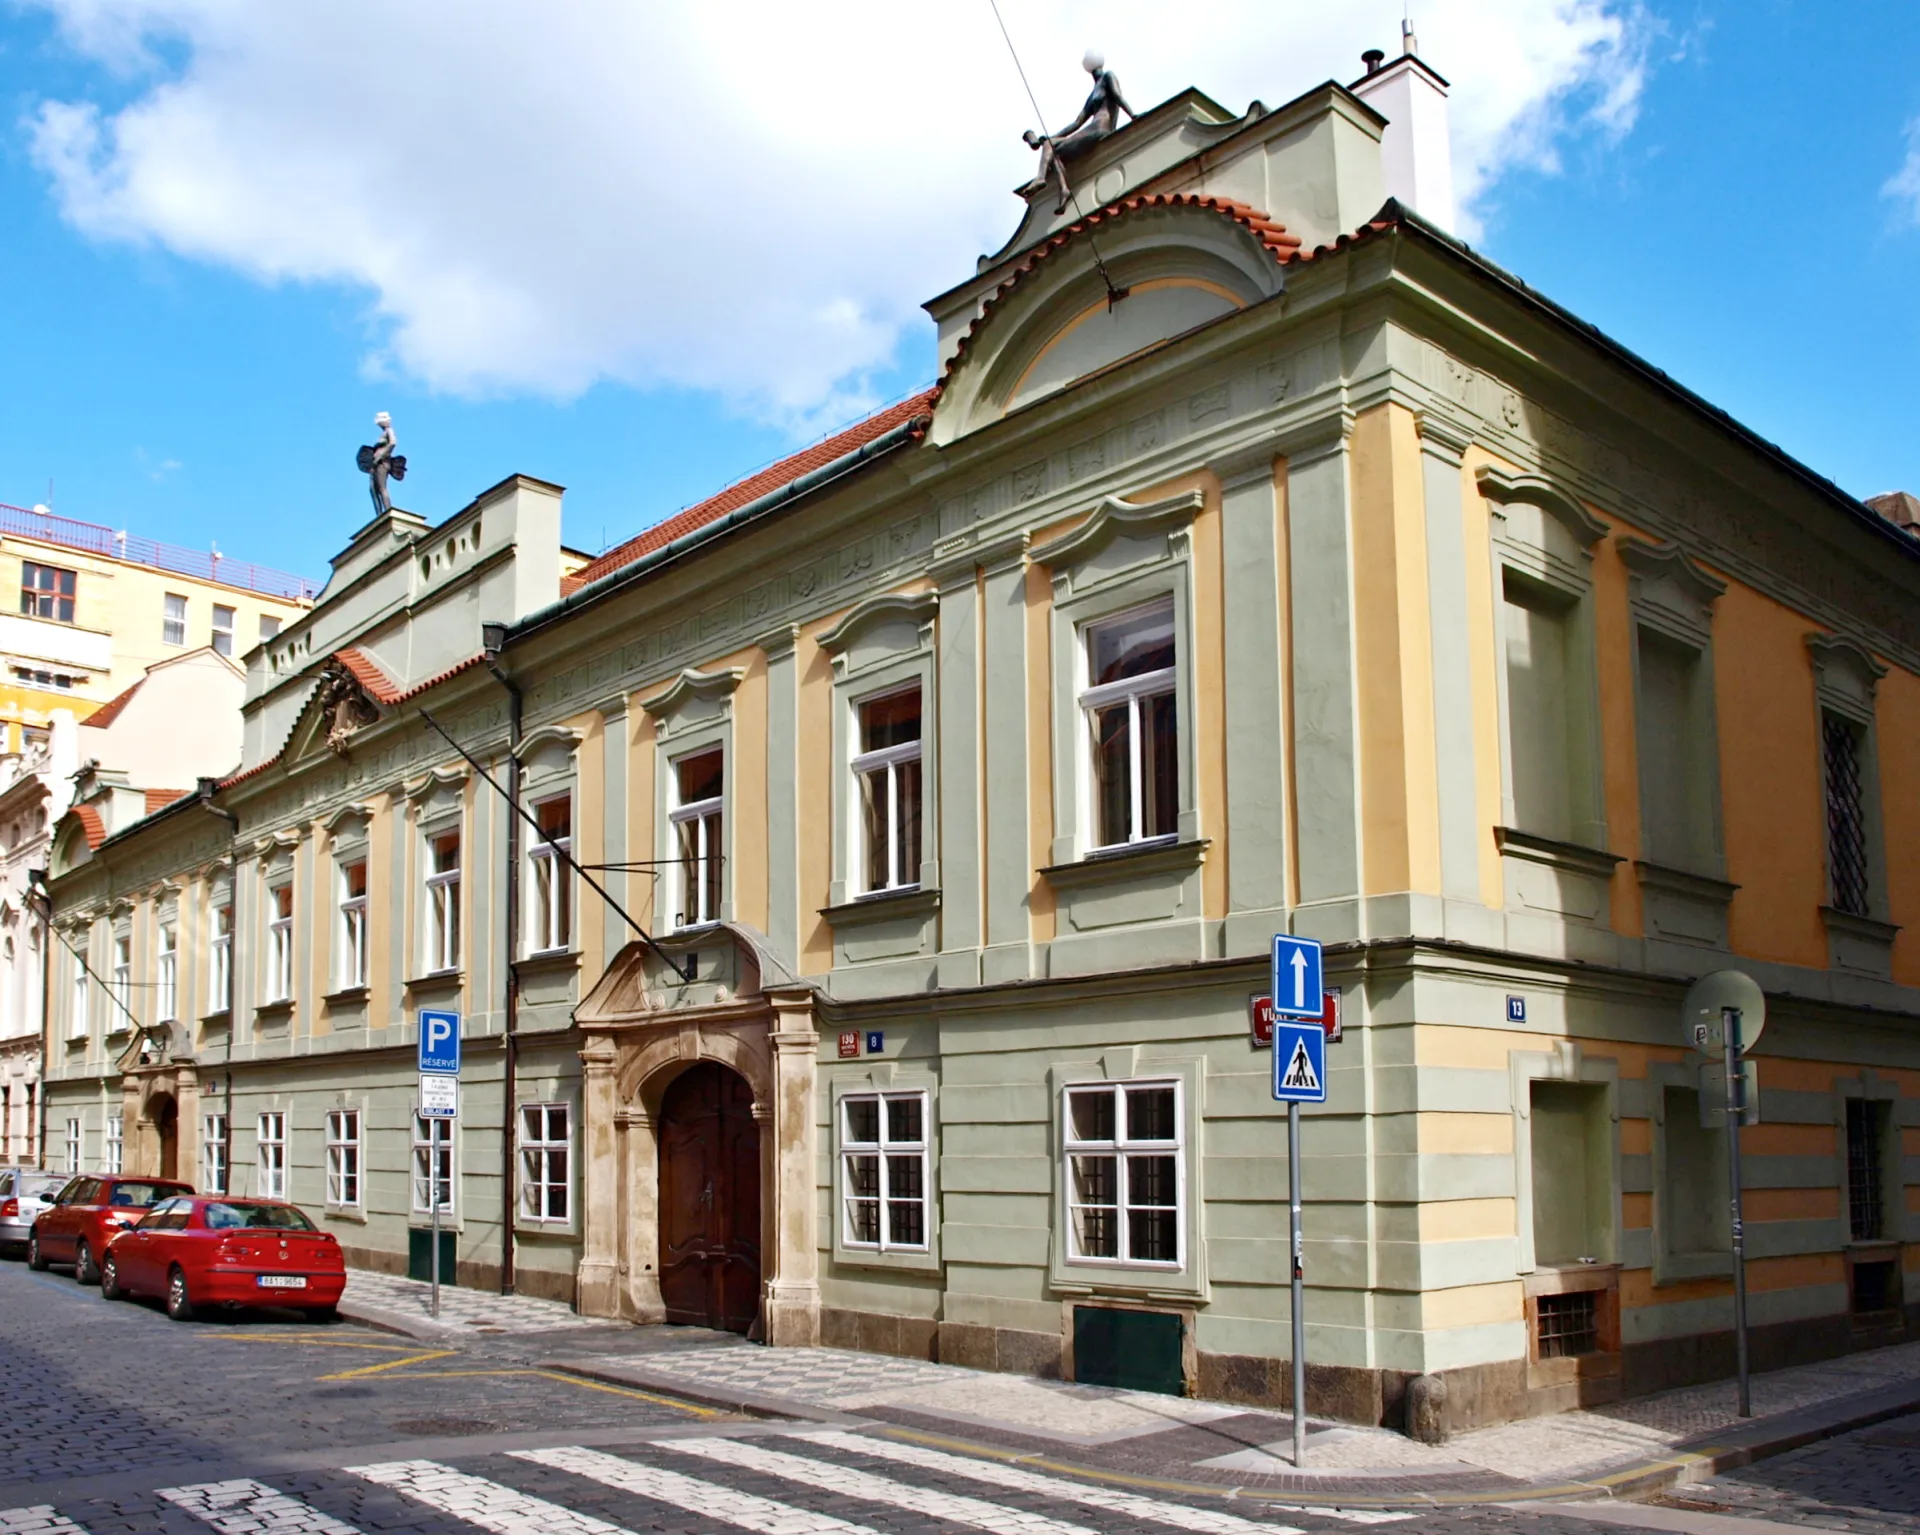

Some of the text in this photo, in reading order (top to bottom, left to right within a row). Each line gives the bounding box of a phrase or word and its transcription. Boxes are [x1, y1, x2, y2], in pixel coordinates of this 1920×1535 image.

[1512, 1001, 1523, 1016] 13
[428, 1018, 451, 1052] P
[871, 1036, 877, 1047] 8
